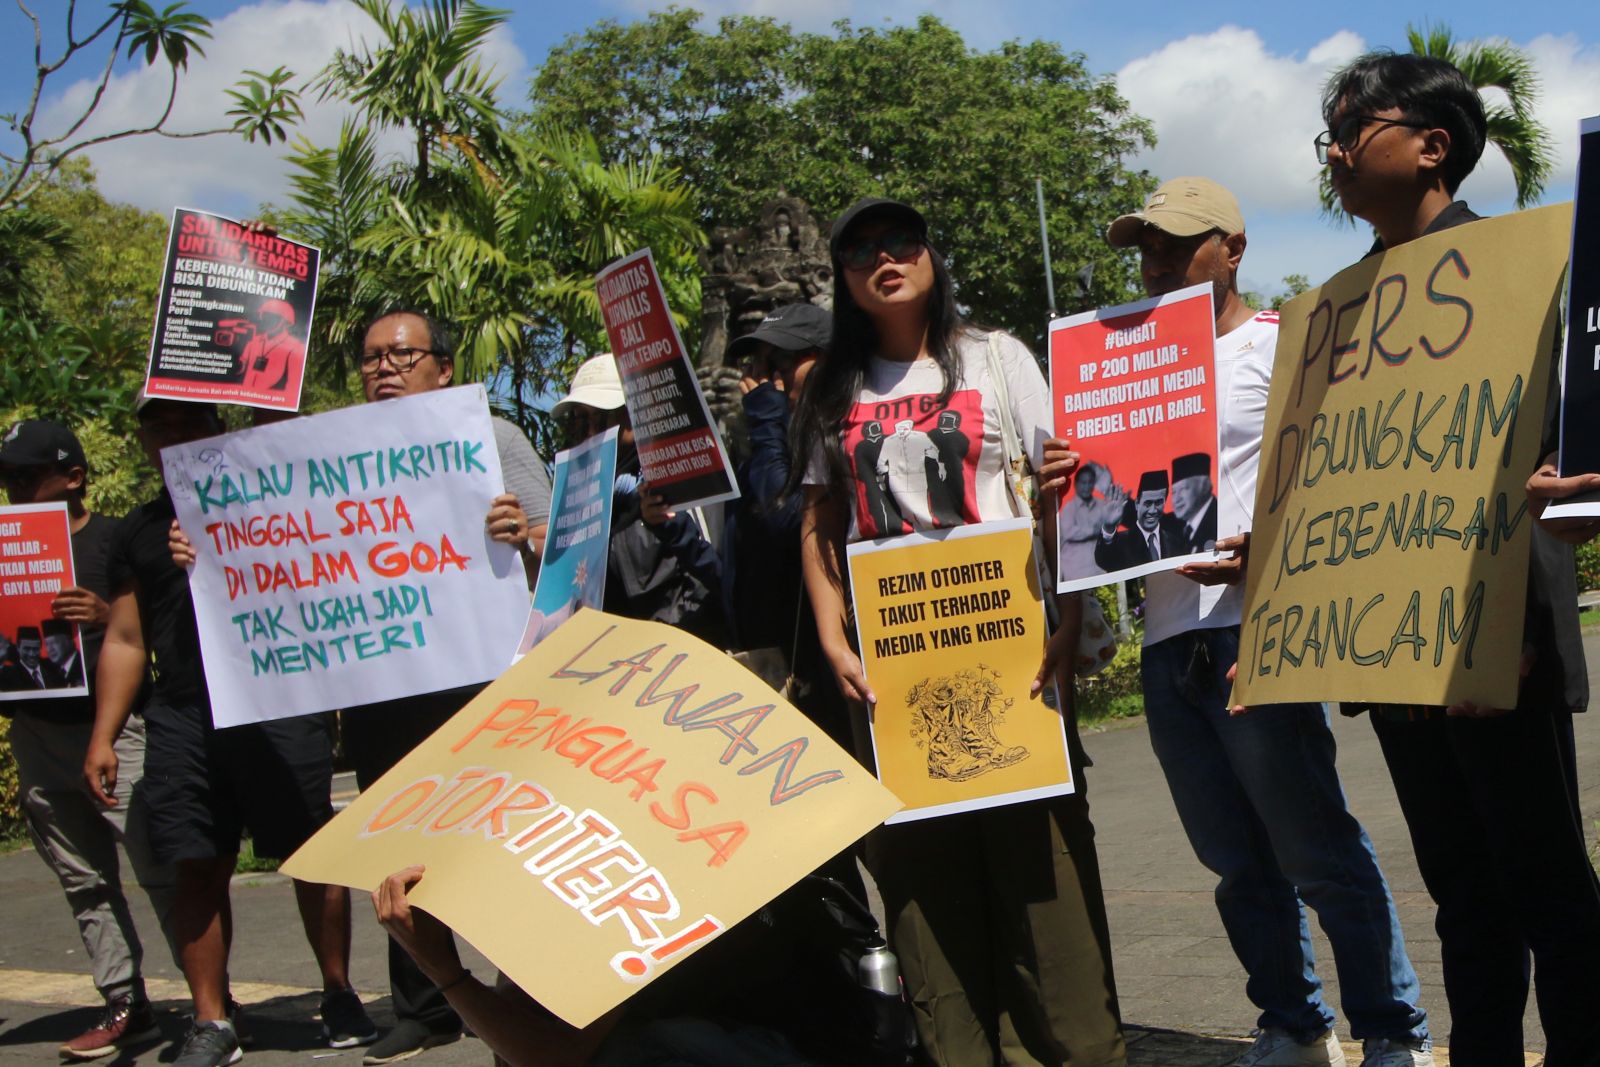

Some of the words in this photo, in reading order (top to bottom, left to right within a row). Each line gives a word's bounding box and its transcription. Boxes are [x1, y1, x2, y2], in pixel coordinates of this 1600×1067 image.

[178, 235, 242, 260] UNTUK
[248, 248, 308, 277] TEMPO
[182, 214, 308, 263] SOLIDARITAS
[171, 287, 202, 298] Lawan
[173, 271, 203, 286] BISA
[206, 276, 286, 300] DIBUNGKAM
[176, 257, 254, 280] KEBENARAN
[257, 269, 295, 290] TIDAK
[168, 305, 192, 316] Pers!
[170, 297, 244, 313] Pembungkaman
[620, 321, 645, 348] BALI
[1105, 321, 1157, 350] #GUGAT
[1297, 248, 1474, 408] PERS
[637, 338, 672, 363] TEMPO
[1080, 363, 1097, 383] RP
[1102, 357, 1129, 379] 200
[1133, 345, 1179, 373] MILIAR
[649, 368, 676, 386] MILIAR
[1064, 377, 1160, 414] BANGKRUTKAN
[1163, 366, 1206, 393] MEDIA
[875, 397, 914, 420] OTT
[1077, 413, 1126, 440] BREDEL
[1129, 405, 1165, 429] GAYA
[1167, 395, 1205, 421] BARU.
[678, 441, 693, 456] TAK
[692, 435, 715, 452] BISA
[1268, 374, 1524, 515] DIBUNGKAM
[195, 462, 294, 514] KALAU
[308, 440, 487, 498] ANTIKRITIK
[667, 459, 692, 476] GANTI
[691, 454, 712, 470] RUGI
[205, 509, 331, 555] TINGGAL
[335, 495, 414, 537] SAJA
[2, 541, 41, 557] MILIAR
[28, 559, 64, 574] MEDIA
[224, 566, 247, 601] DI
[255, 551, 359, 594] DALAM
[367, 533, 472, 578] GOA
[3, 581, 31, 596] GAYA
[878, 572, 927, 597] REZIM
[931, 560, 1004, 588] OTORITER
[231, 605, 296, 644] TAK
[299, 590, 368, 633] USAH
[372, 584, 433, 620] JADI
[879, 602, 926, 627] TAKUT
[930, 589, 1011, 621] TERHADAP
[251, 620, 426, 677] MENTERI
[875, 632, 926, 658] MEDIA
[929, 626, 972, 649] YANG
[977, 617, 1025, 642] KRITIS
[1249, 581, 1485, 686] TERANCAM
[550, 625, 843, 806] LAWAN
[451, 698, 750, 867] PENGUASA
[357, 766, 725, 984] OTORITER!
